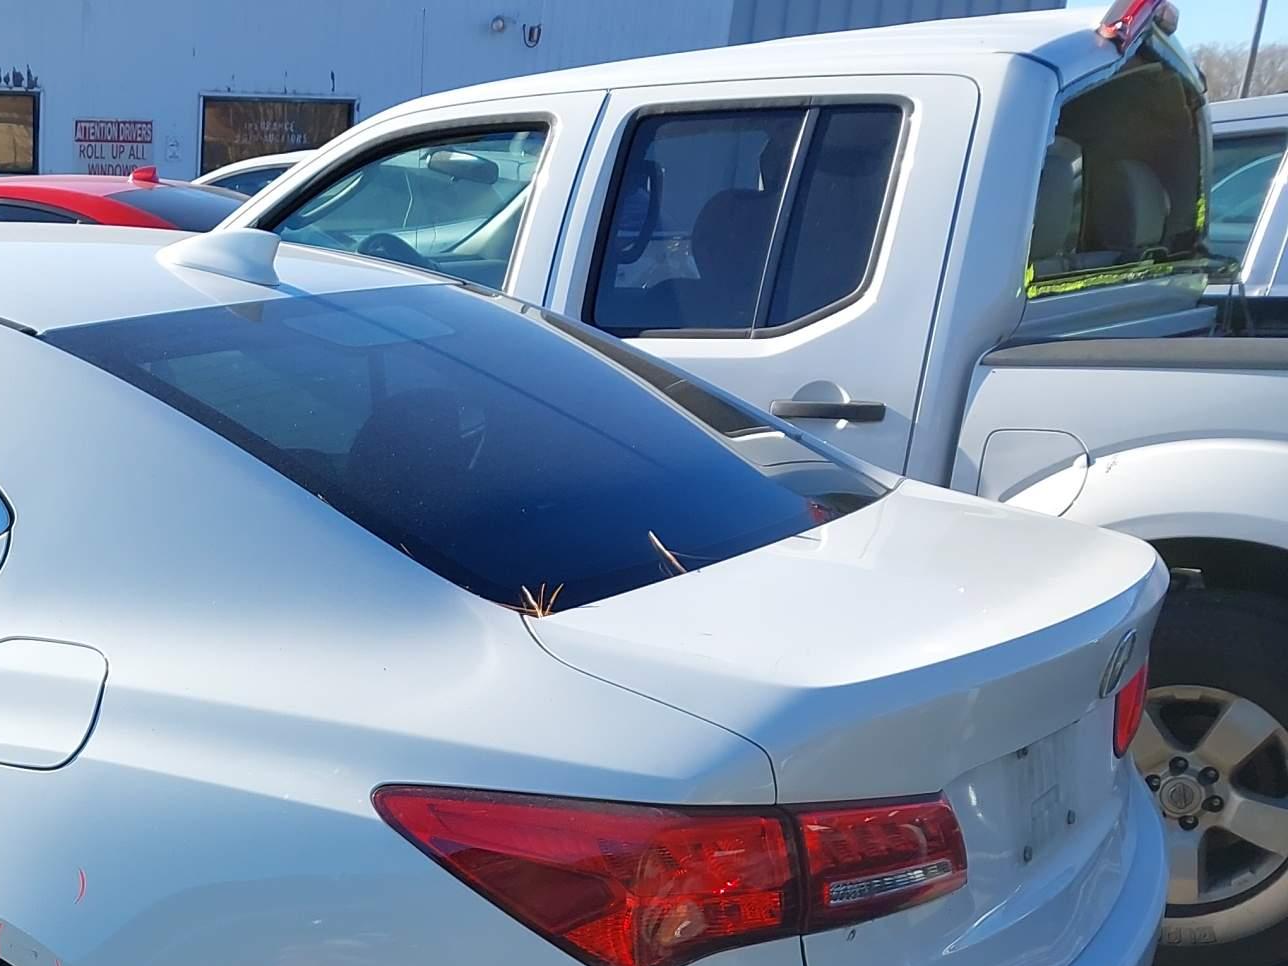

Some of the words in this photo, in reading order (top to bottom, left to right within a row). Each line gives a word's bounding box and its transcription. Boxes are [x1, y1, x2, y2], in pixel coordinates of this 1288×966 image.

[75, 121, 118, 140] ATTENTION
[119, 122, 152, 141] DRIVERS
[79, 144, 105, 159] ROLL
[112, 144, 125, 159] UP
[128, 144, 147, 160] ALL
